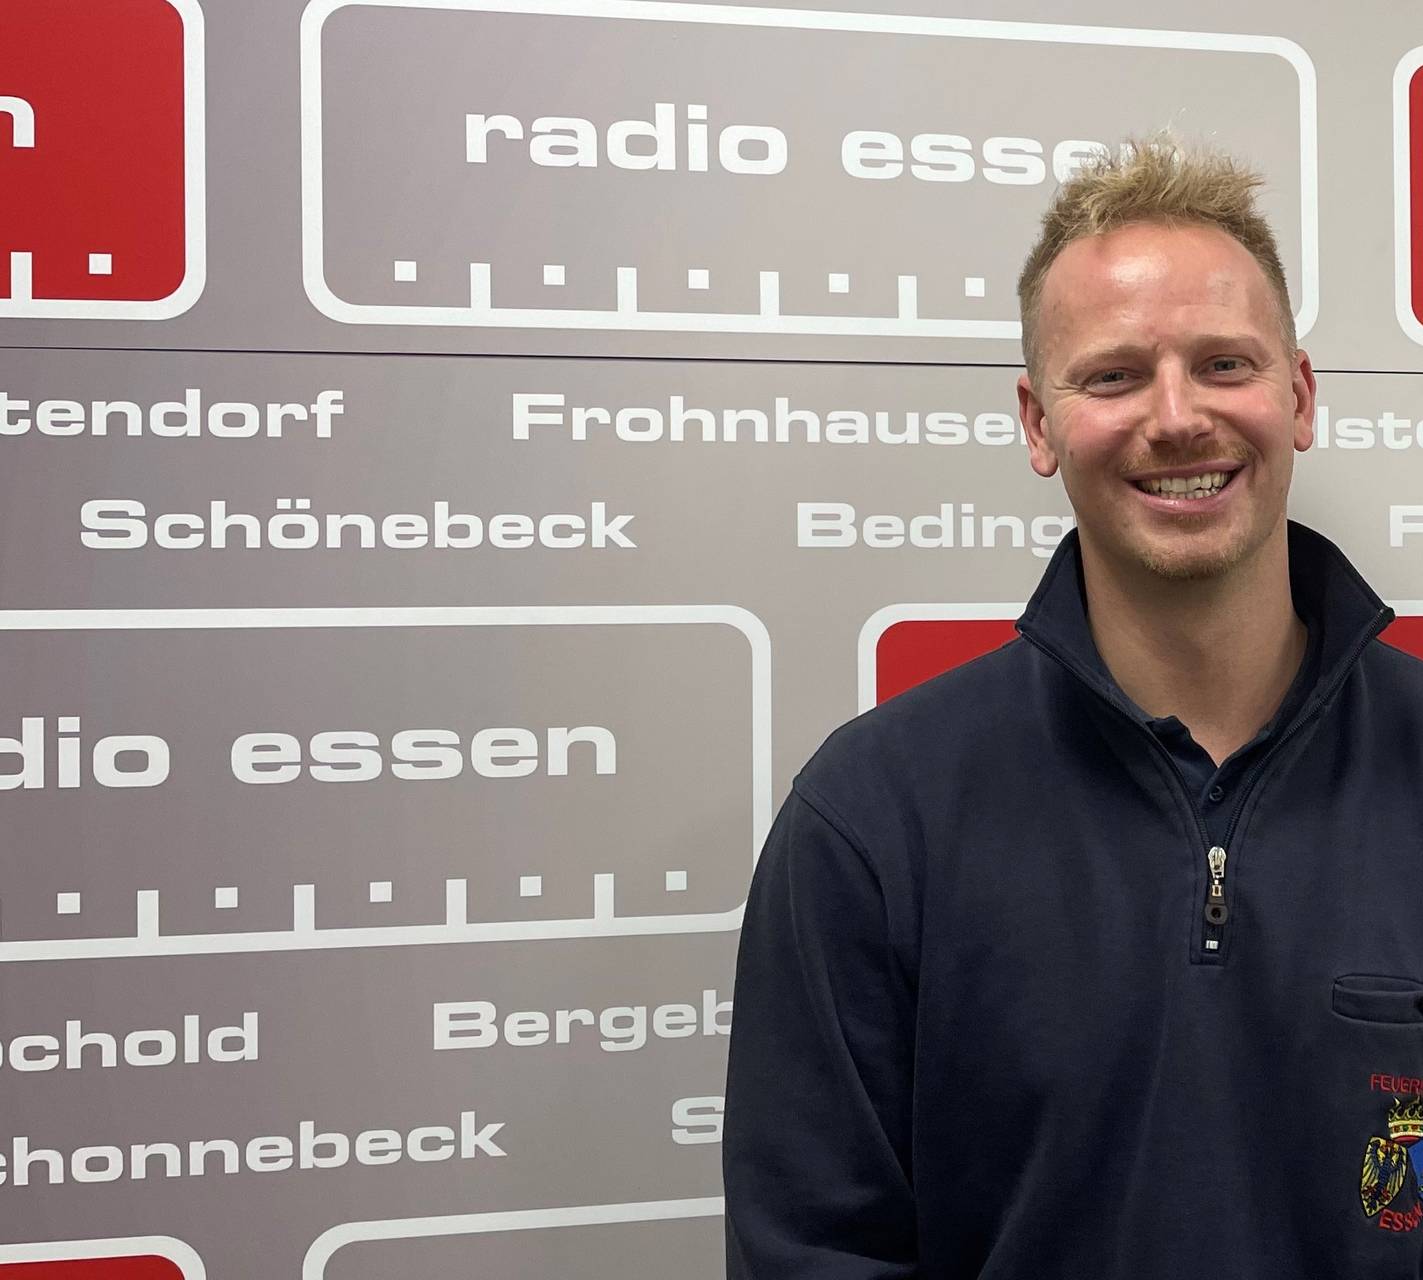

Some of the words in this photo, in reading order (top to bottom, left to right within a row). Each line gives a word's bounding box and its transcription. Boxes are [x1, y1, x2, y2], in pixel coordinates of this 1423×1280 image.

[465, 103, 788, 174] radio
[0, 389, 345, 438] tendorf
[512, 393, 1027, 446] Frohnhause
[80, 498, 638, 550] Schönebeck
[797, 503, 1074, 558] Beding
[230, 725, 617, 784] essen
[0, 1012, 259, 1072] chold
[0, 1111, 508, 1186] honnebeck
